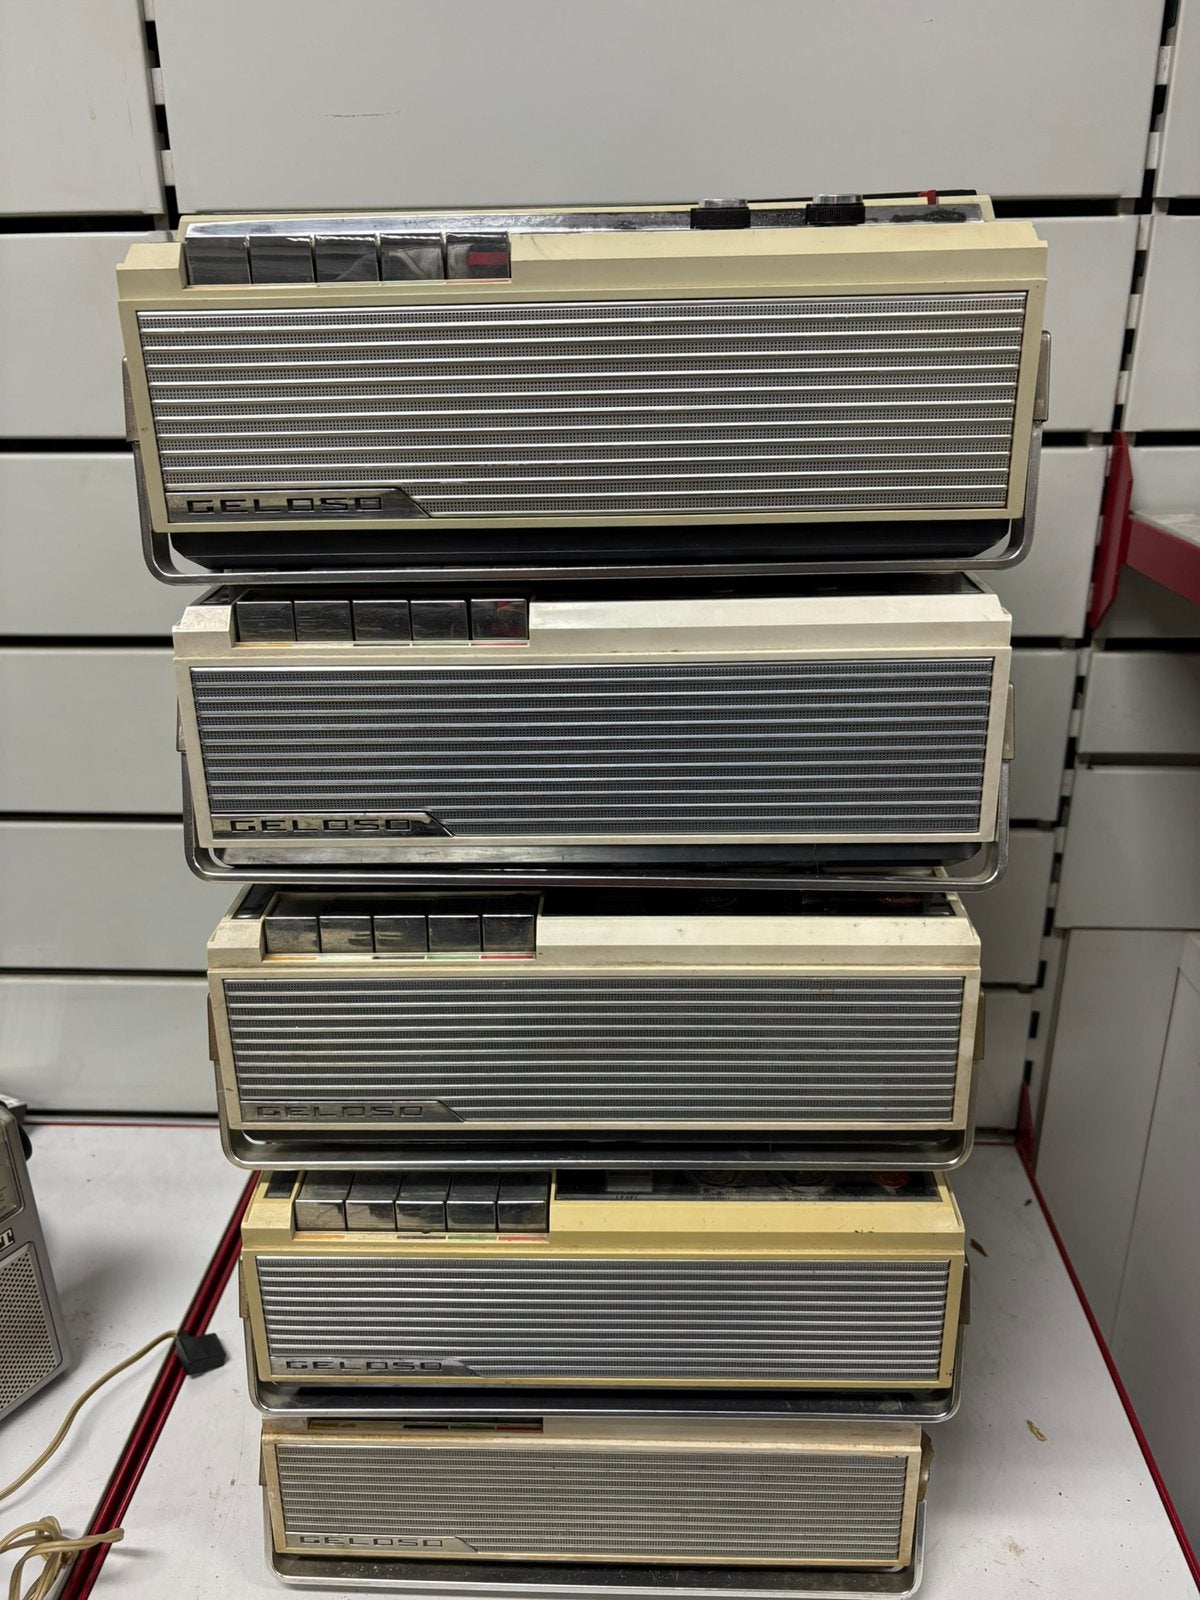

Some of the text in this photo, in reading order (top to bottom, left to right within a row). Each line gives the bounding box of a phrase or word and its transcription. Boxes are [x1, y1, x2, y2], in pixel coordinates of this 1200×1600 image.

[186, 497, 382, 514] GELOSO
[230, 819, 412, 832] GELOSO
[257, 1106, 423, 1117] GELOSO
[286, 1361, 441, 1371] GELOSO
[300, 1536, 442, 1547] GELOSO
